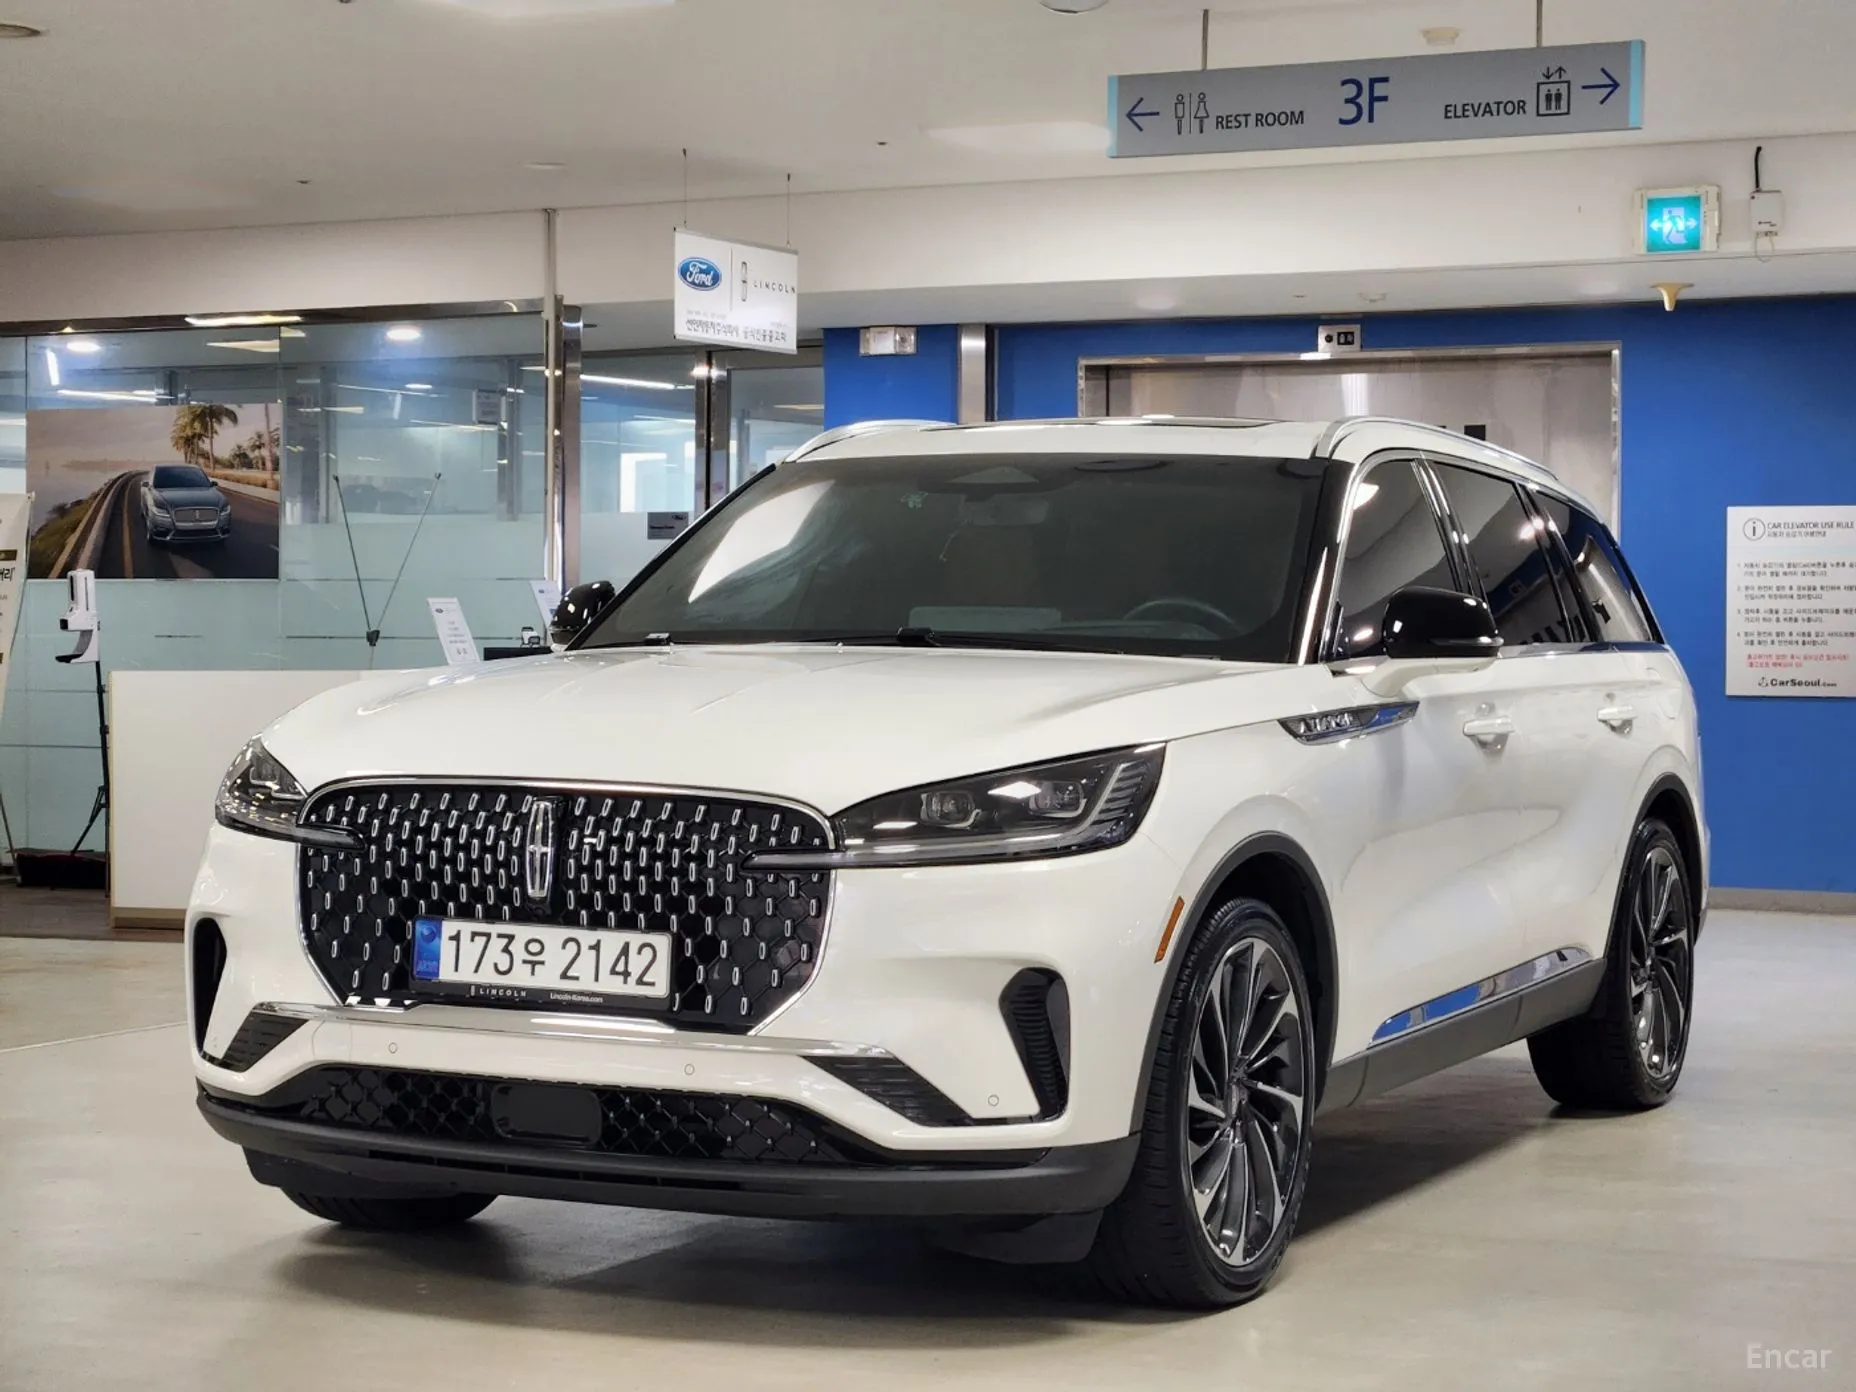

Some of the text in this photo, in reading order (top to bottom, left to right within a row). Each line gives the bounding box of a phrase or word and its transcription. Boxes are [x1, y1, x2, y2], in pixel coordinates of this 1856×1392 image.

[1338, 75, 1390, 125] 3F
[1443, 99, 1527, 120] ELEVATOR
[1215, 109, 1305, 130] REST ROOM
[686, 260, 714, 287] Ford
[753, 280, 796, 294] LINCOLN
[1767, 521, 1781, 529] CAR
[1783, 521, 1819, 529] ELEVATOR
[1820, 521, 1834, 529] USE
[447, 929, 658, 987] 173우 2142
[479, 987, 527, 997] LINCOLN
